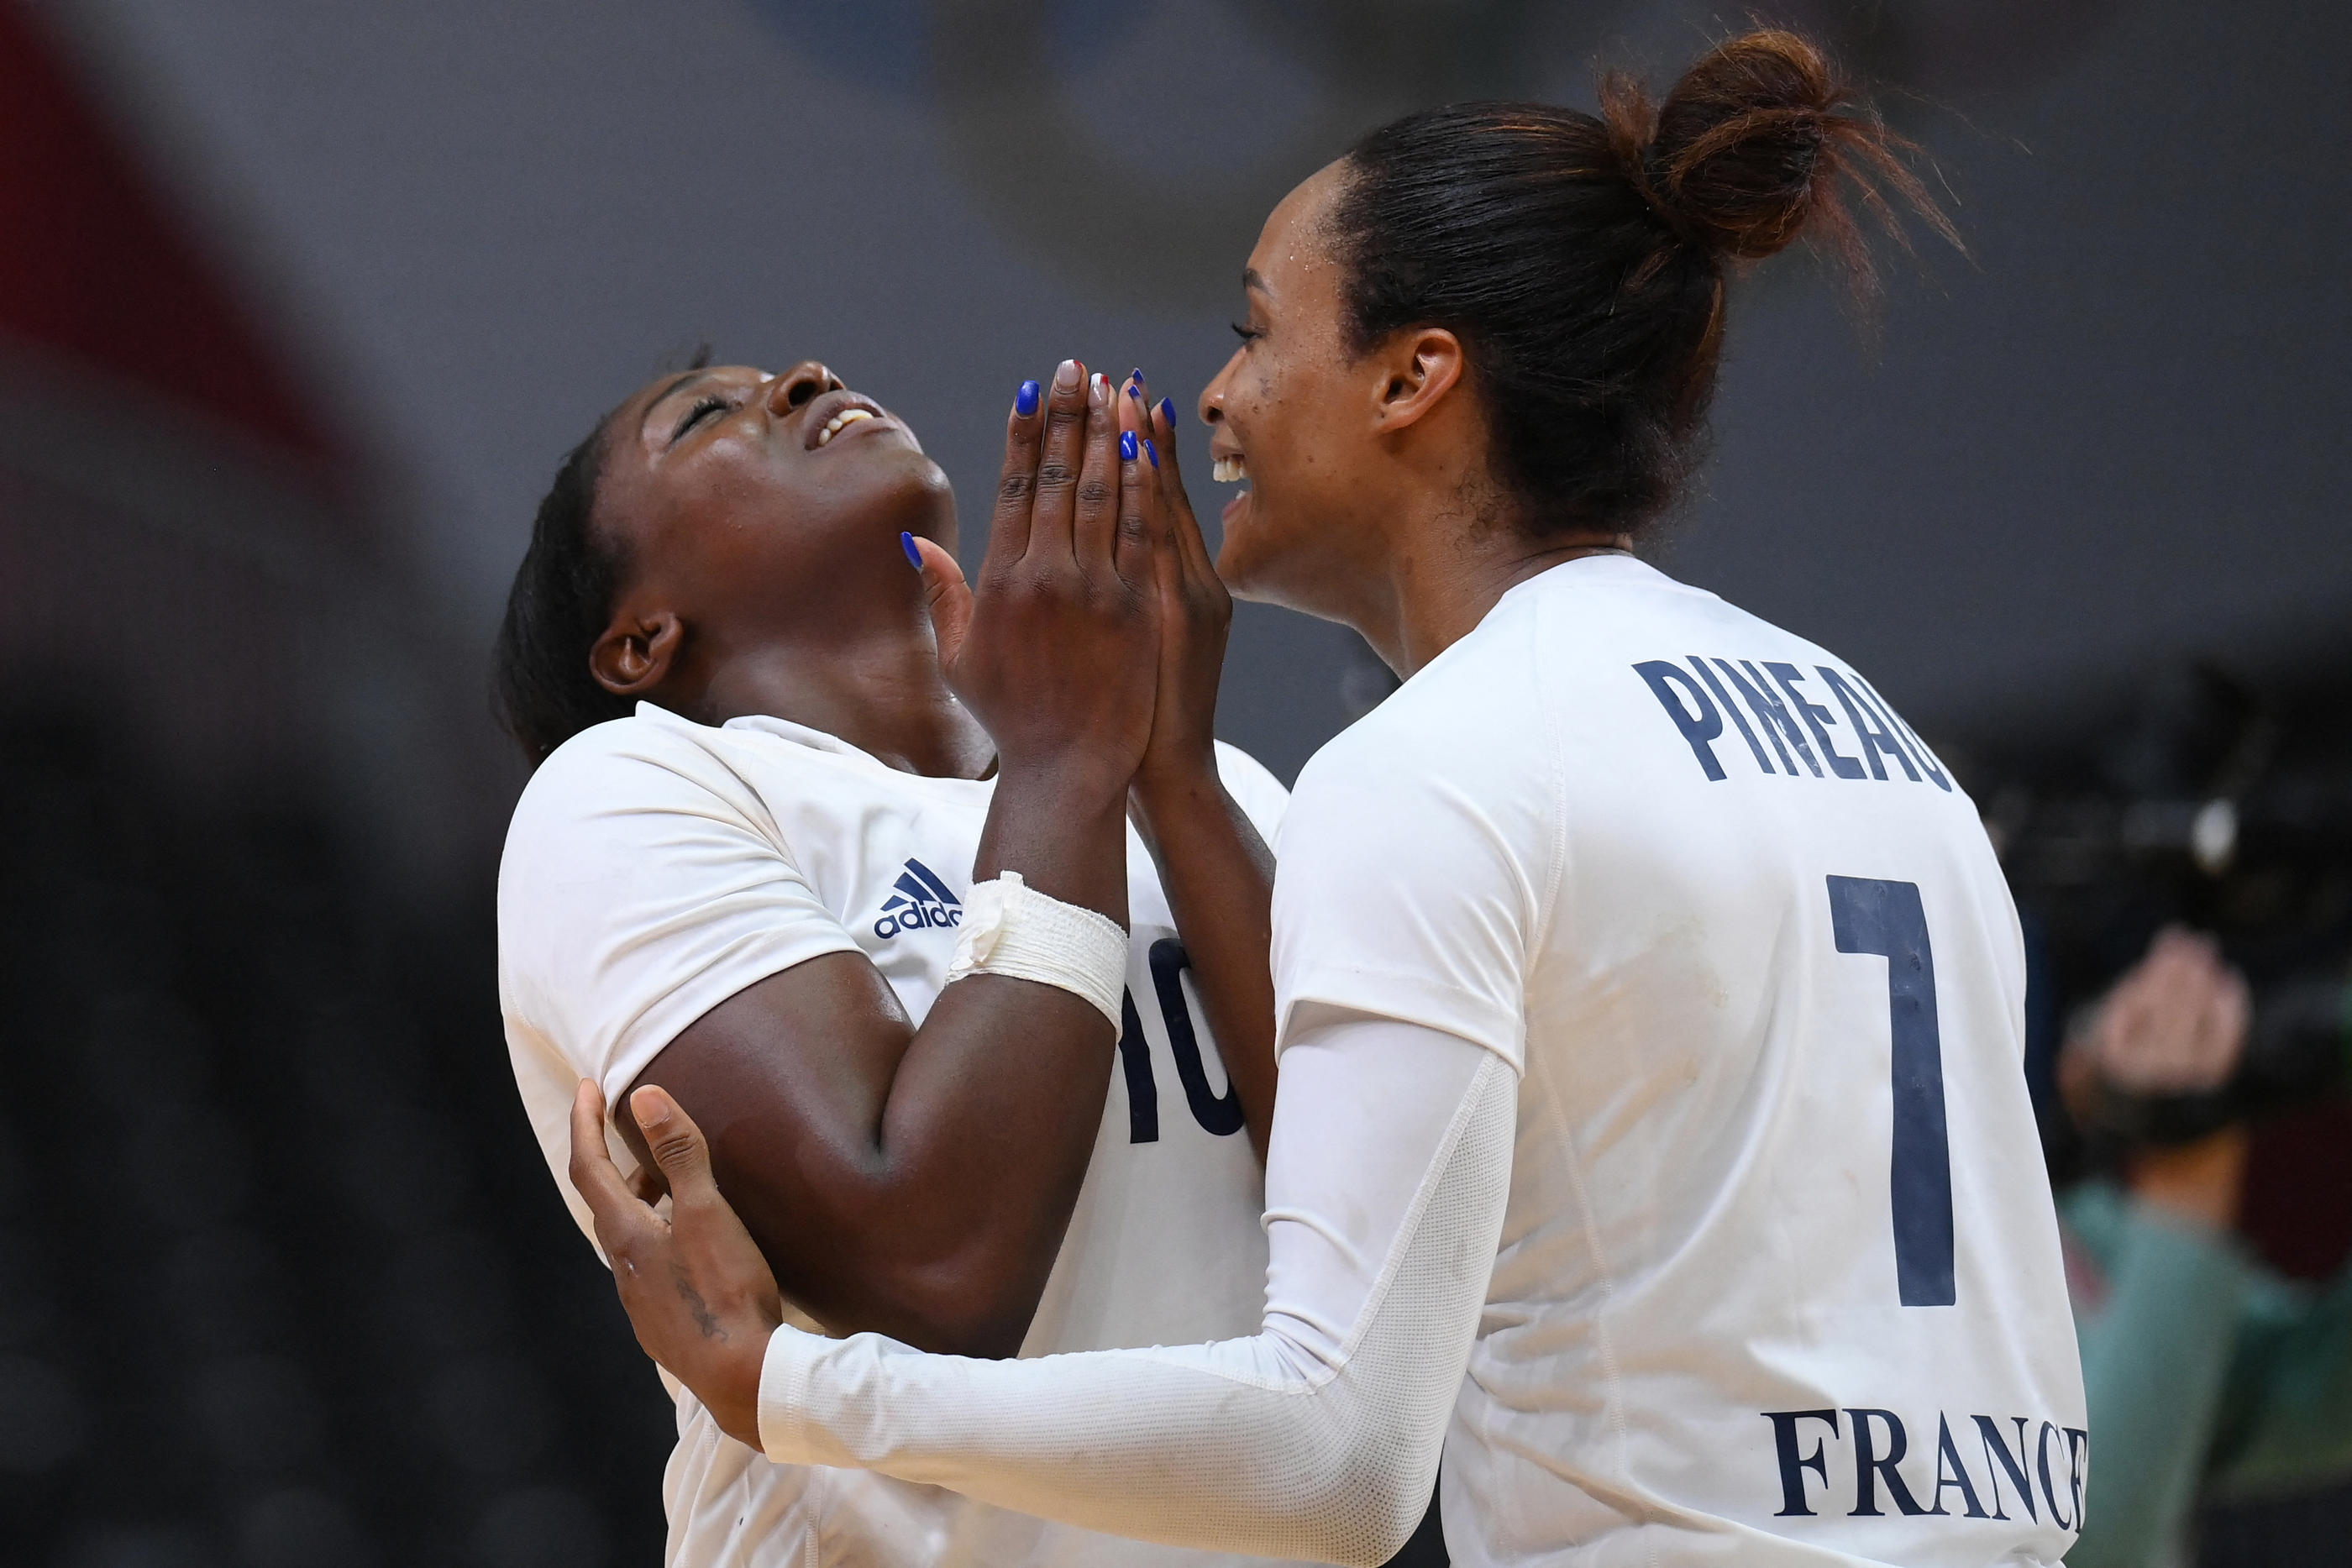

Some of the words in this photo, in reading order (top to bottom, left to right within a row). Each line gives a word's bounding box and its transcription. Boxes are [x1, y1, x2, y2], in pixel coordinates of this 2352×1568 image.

[1630, 655, 1952, 792] PINEAU
[874, 901, 963, 939] adida
[1826, 874, 1956, 1307] 7
[1761, 1408, 2087, 1534] FRANCE
